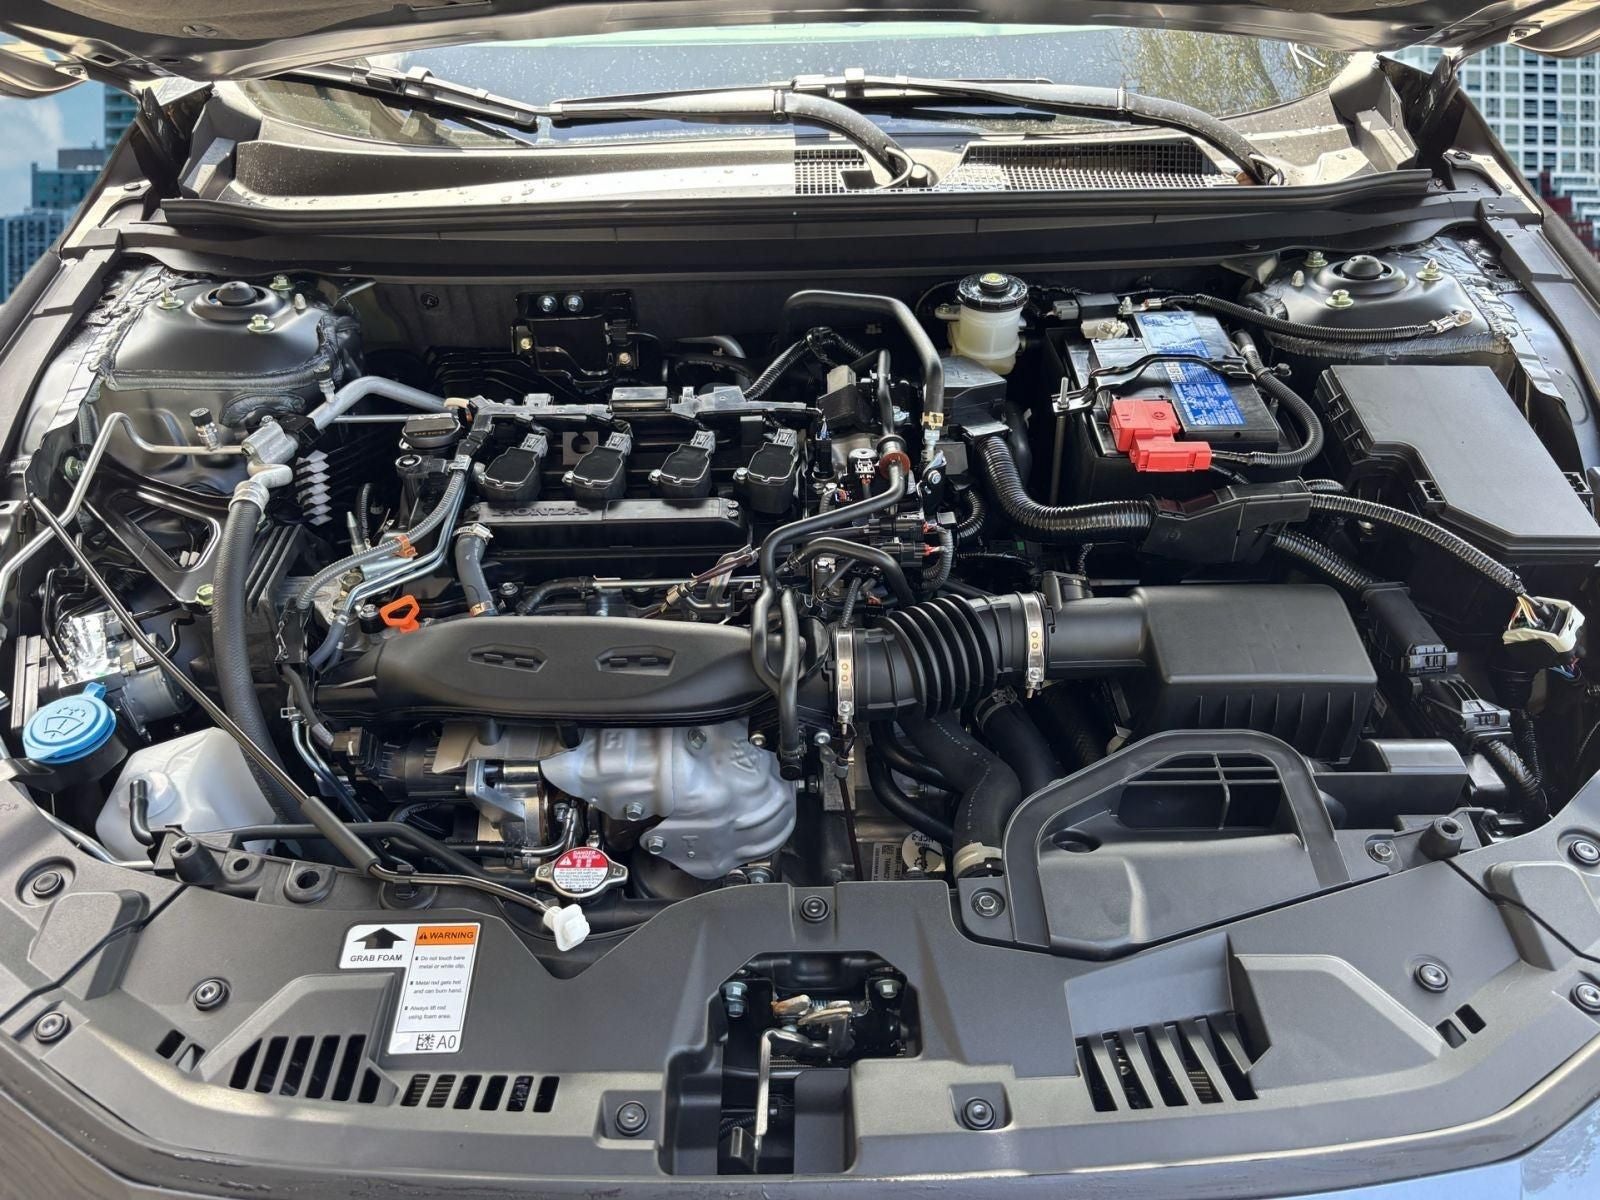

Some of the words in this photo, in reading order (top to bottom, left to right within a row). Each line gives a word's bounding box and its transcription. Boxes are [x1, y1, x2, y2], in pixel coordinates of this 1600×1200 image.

[430, 931, 474, 940] WARNING
[350, 954, 376, 962] GRAB
[376, 954, 403, 962] FOAM
[436, 1035, 457, 1049] A0
